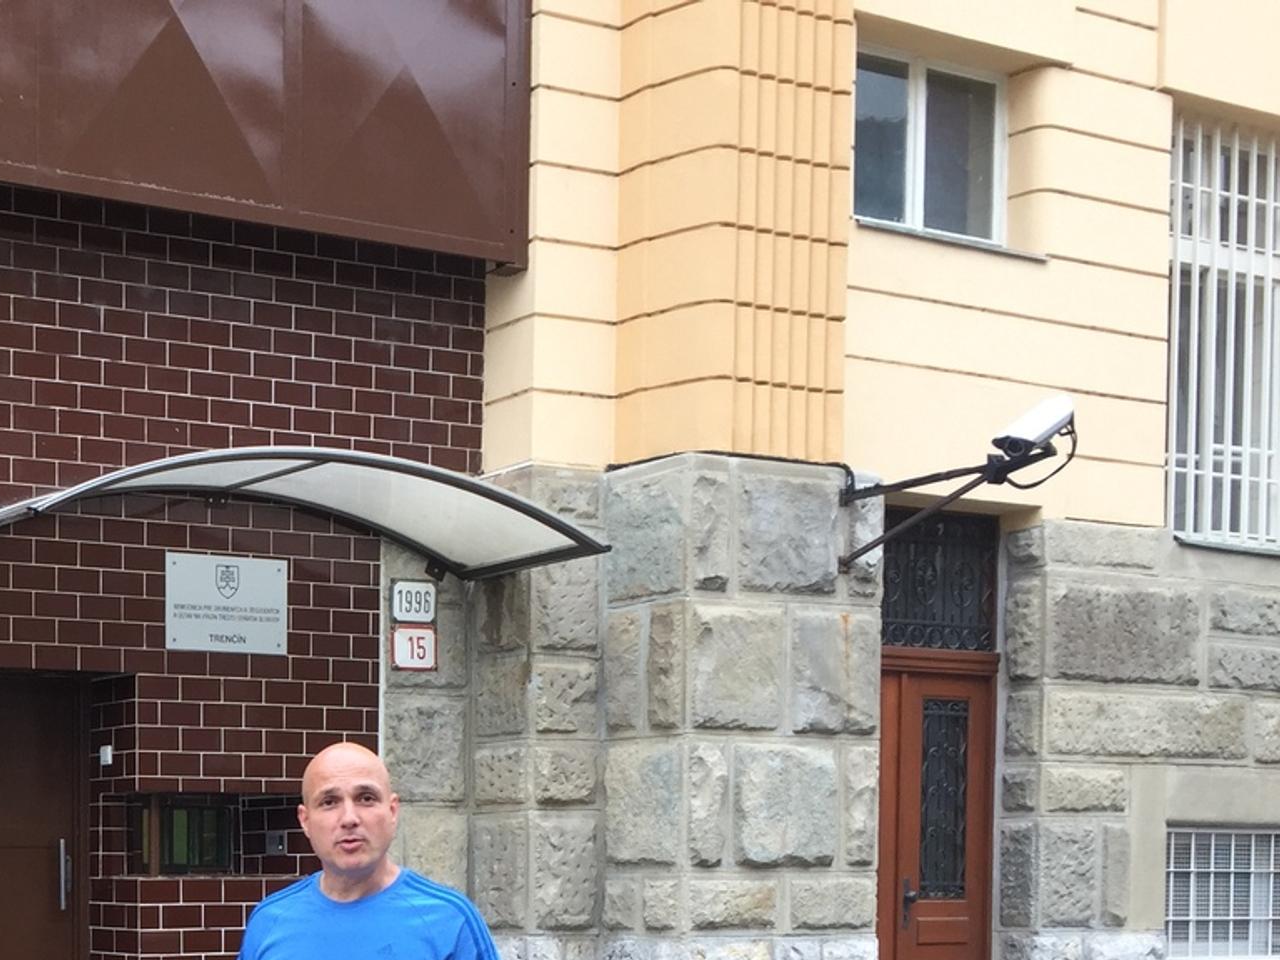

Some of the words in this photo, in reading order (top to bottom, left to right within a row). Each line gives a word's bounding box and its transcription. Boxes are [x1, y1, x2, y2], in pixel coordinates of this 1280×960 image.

[397, 589, 432, 614] 1996
[208, 633, 247, 645] TRENČÍN
[407, 635, 427, 660] 15
